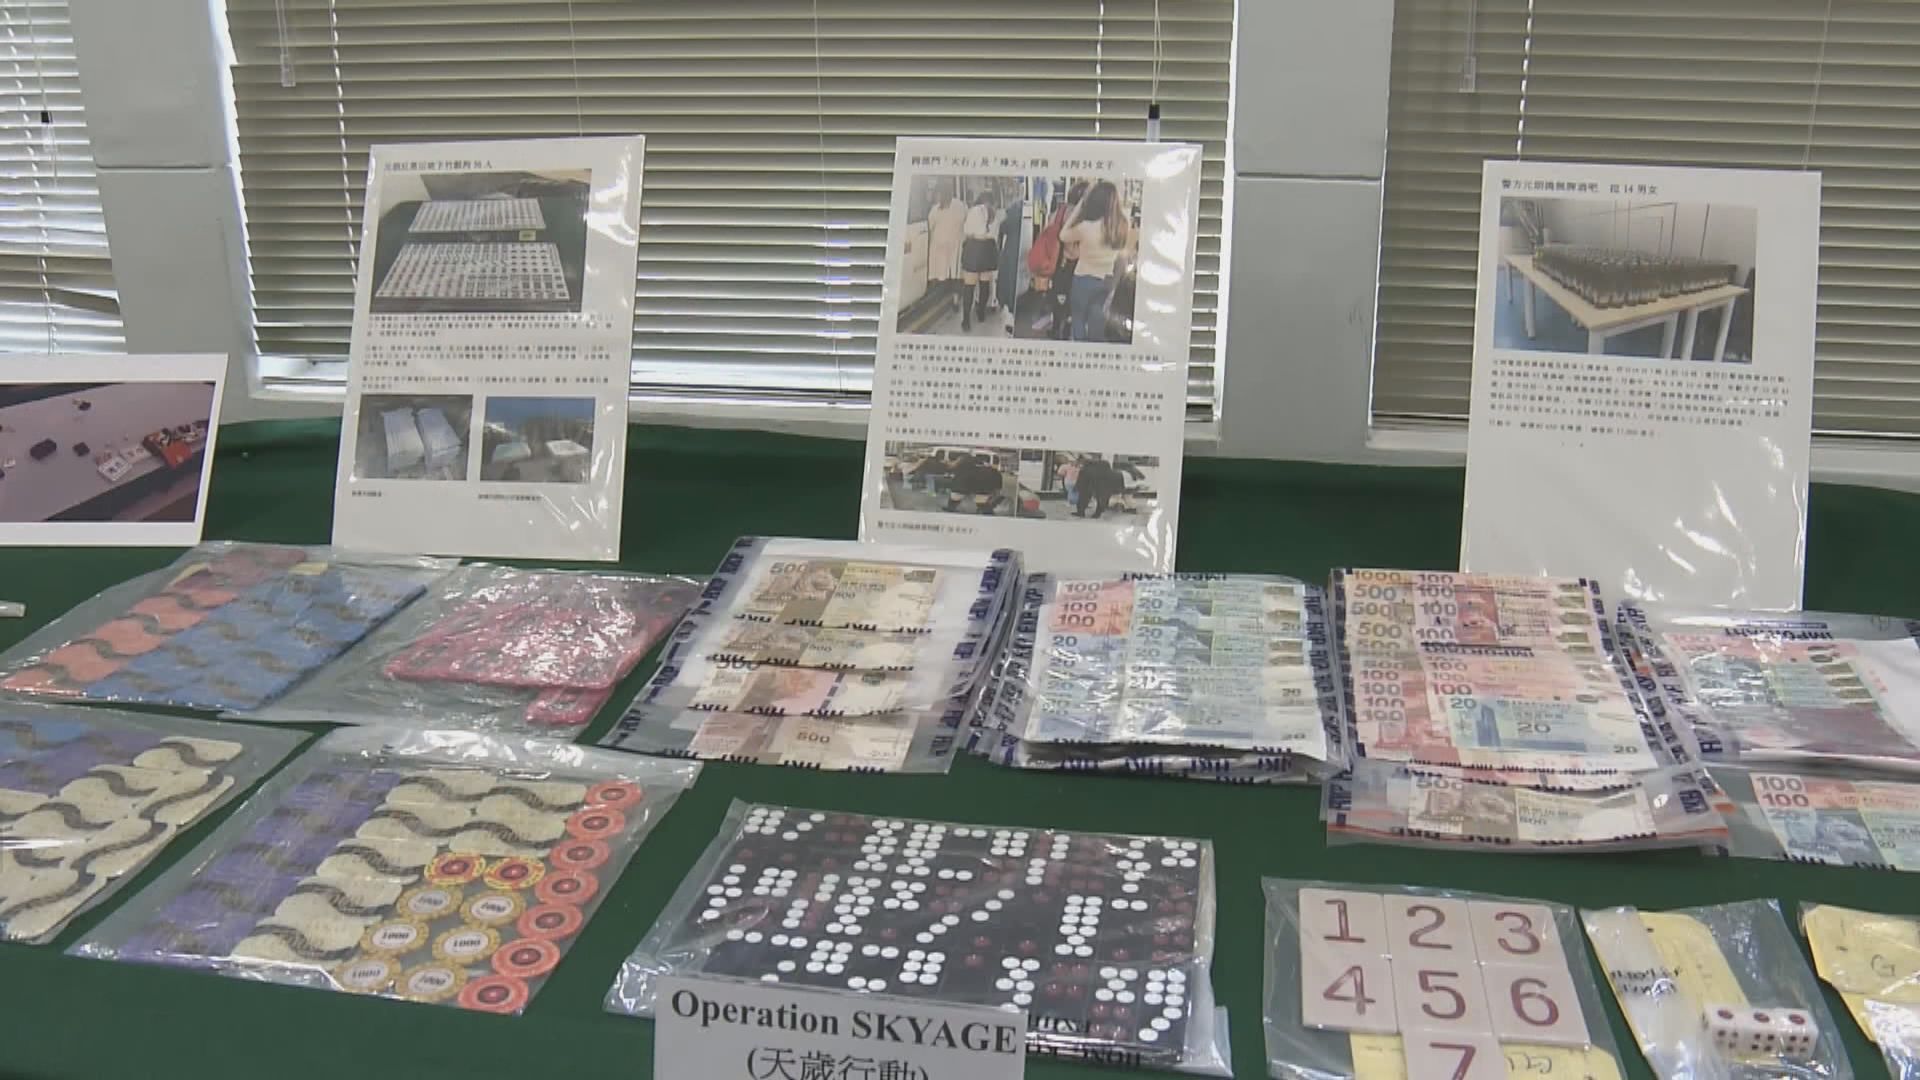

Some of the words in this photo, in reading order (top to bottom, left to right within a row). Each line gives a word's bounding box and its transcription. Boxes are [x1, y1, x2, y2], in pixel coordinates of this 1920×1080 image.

[771, 562, 808, 575] 500
[1417, 574, 1454, 584] 100
[1065, 583, 1100, 592] 100
[1354, 585, 1397, 600] 500
[1063, 602, 1097, 613] 100
[1351, 602, 1394, 618] 500
[1421, 602, 1457, 616] 100
[1058, 614, 1095, 627] 100
[1358, 622, 1403, 638] 500
[1416, 628, 1454, 640] 100
[1053, 636, 1078, 647] 20
[1360, 671, 1399, 681] 100
[1363, 683, 1401, 696] 100
[1433, 684, 1472, 695] 100
[1450, 698, 1477, 709] 20
[1516, 722, 1551, 734] 20
[797, 732, 831, 744] 500
[1613, 745, 1638, 754] 20
[1755, 776, 1804, 791] 100
[1762, 794, 1810, 808] 100
[1323, 900, 1366, 943] 1
[1406, 904, 1452, 950] 2
[1495, 911, 1541, 955] 3
[453, 939, 481, 949] 1000
[1323, 965, 1376, 1015] 4
[1418, 970, 1466, 1019] 5
[1511, 977, 1559, 1026] 6
[671, 990, 839, 1036] Operation
[852, 1010, 1018, 1054] SKYAGE
[747, 1047, 929, 1080] (天歲行動)
[1429, 1042, 1477, 1080] 7
